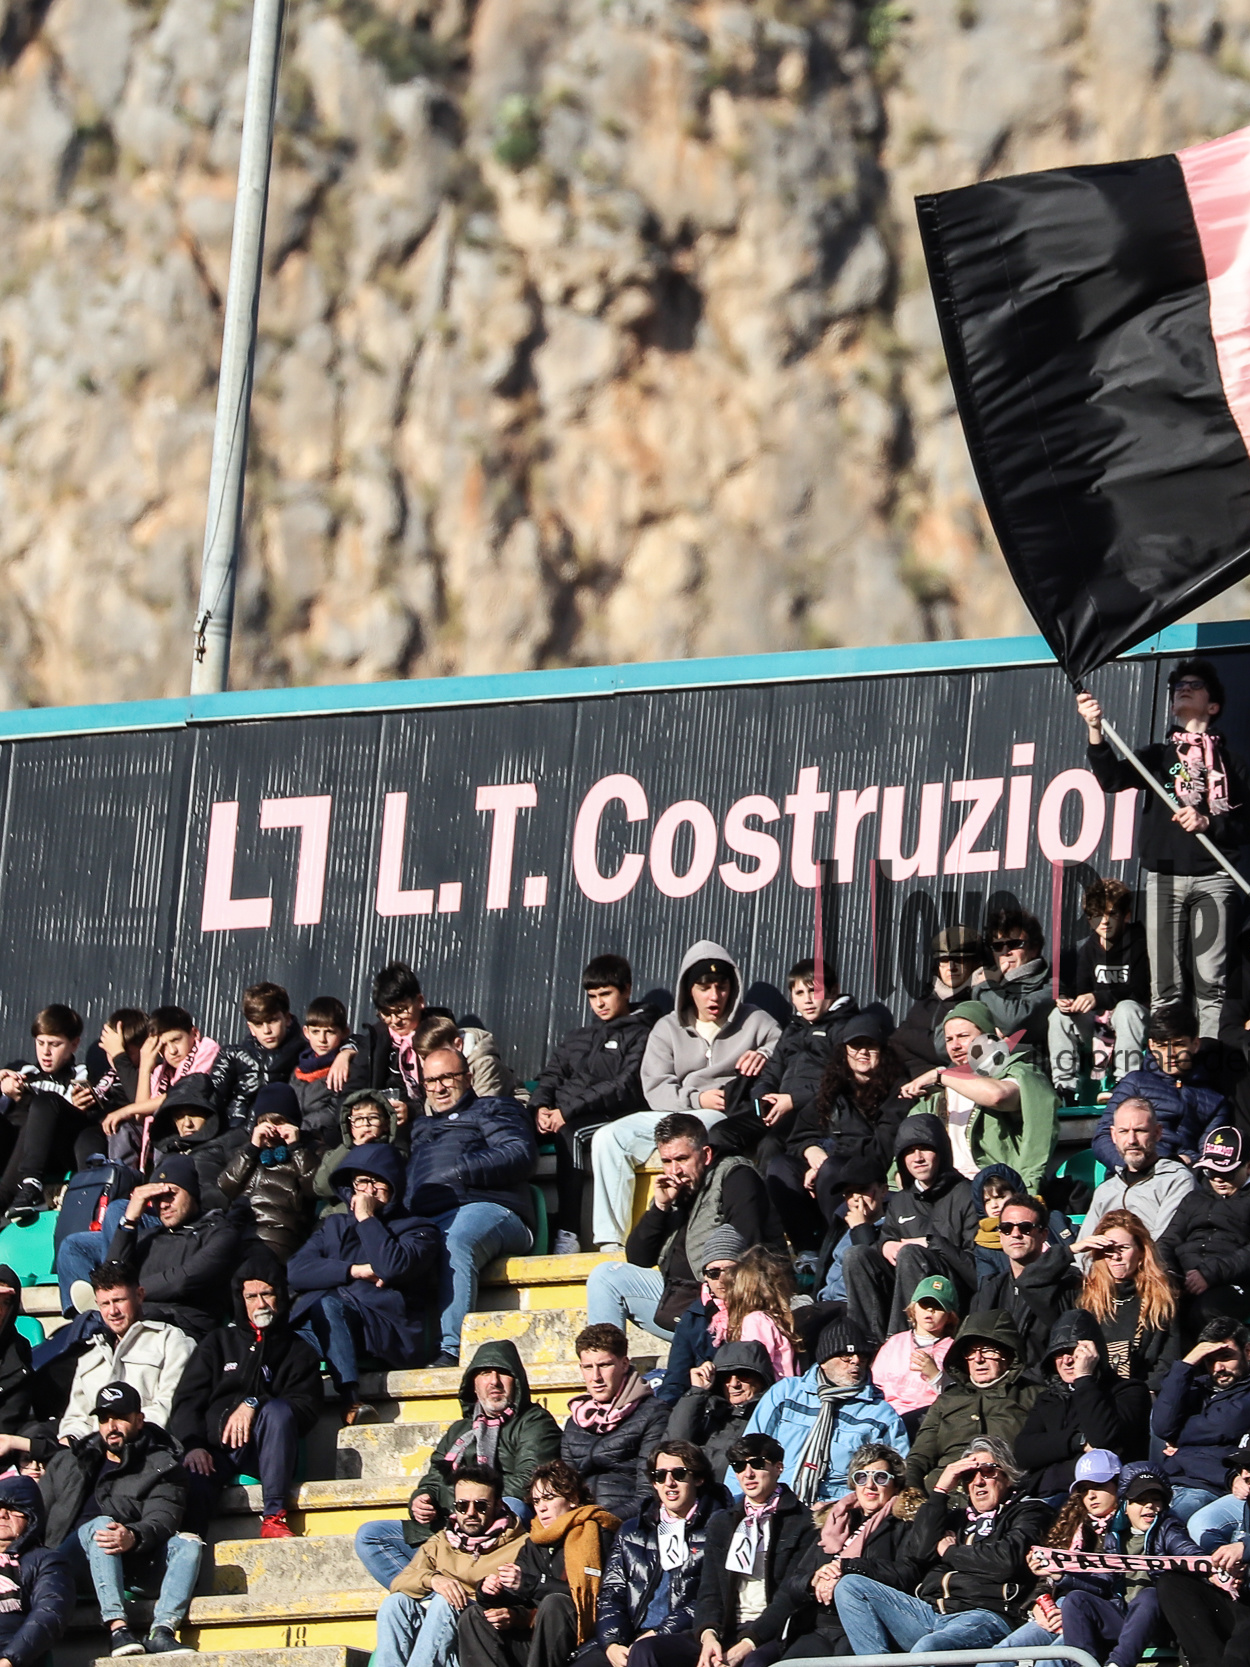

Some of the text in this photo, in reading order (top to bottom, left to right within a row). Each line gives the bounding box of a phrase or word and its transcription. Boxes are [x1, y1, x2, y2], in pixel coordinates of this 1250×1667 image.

[376, 782, 548, 917] L.T.
[1094, 965, 1129, 983] VANS
[1051, 1551, 1212, 1576] PALERMO
